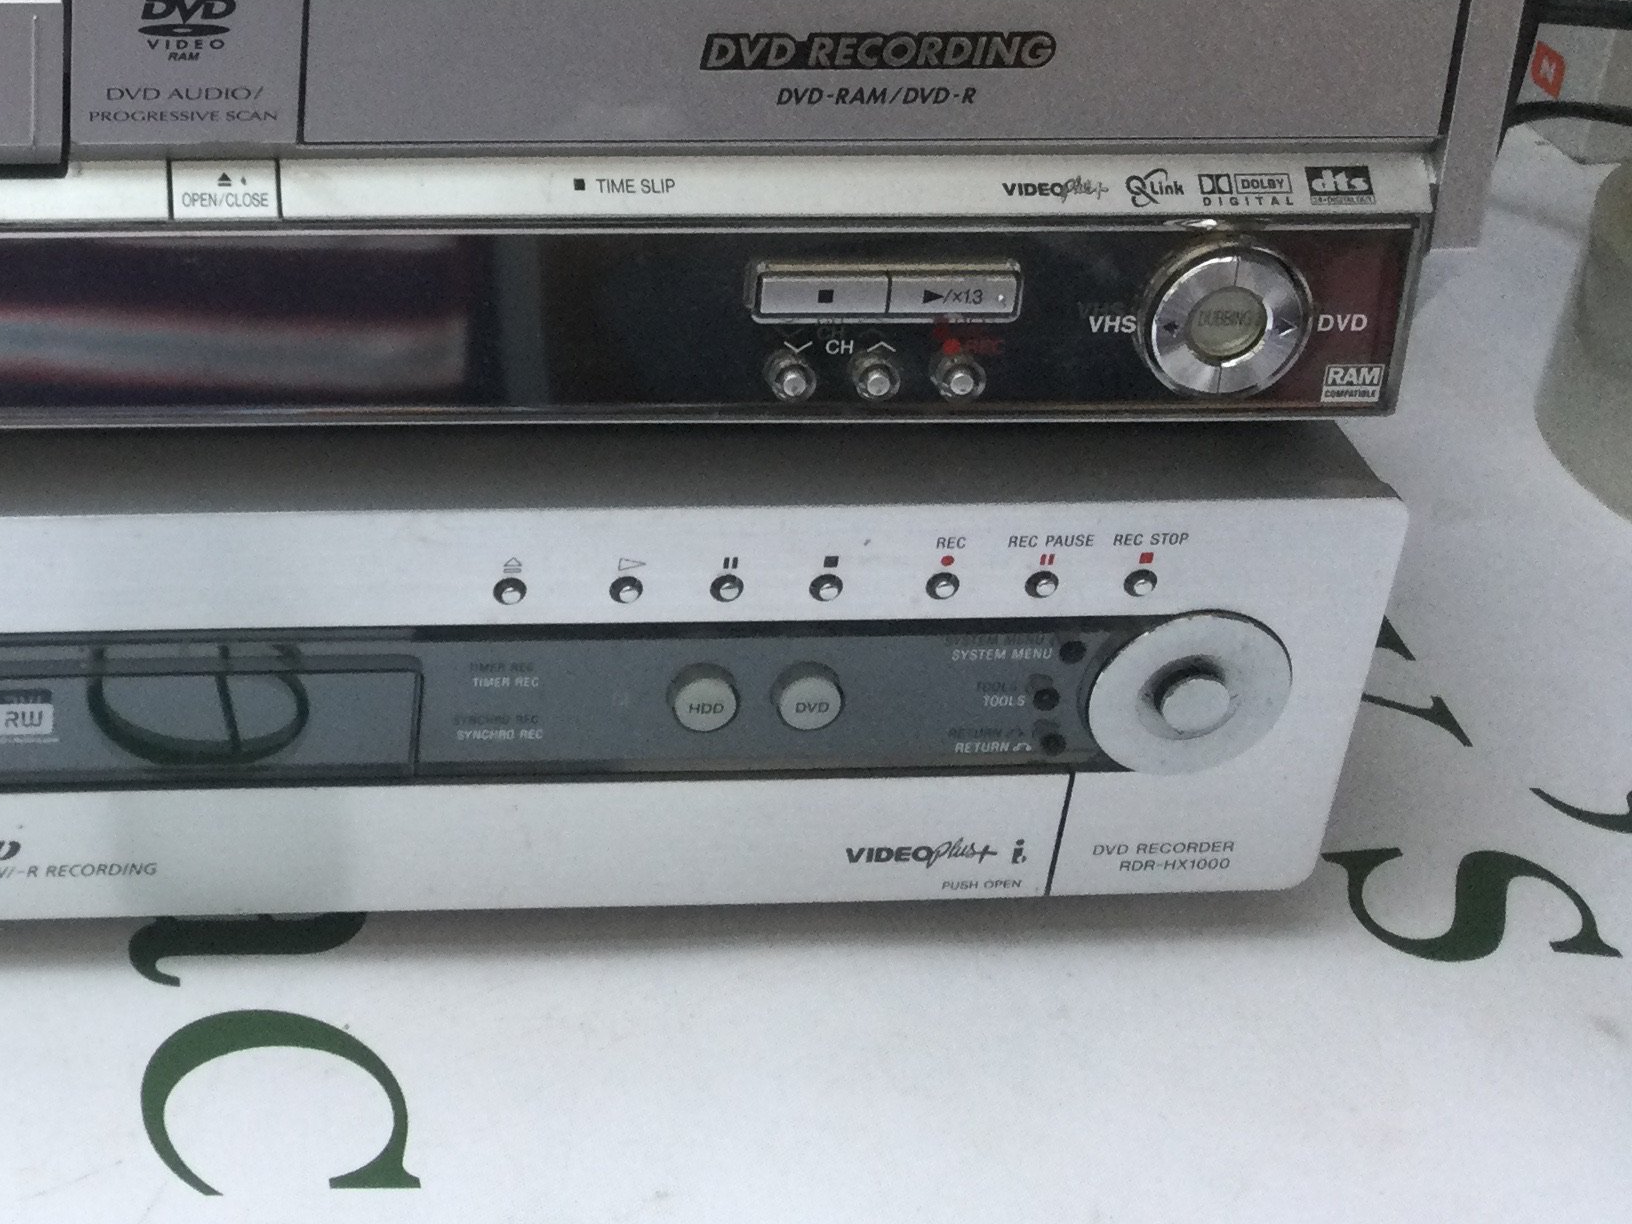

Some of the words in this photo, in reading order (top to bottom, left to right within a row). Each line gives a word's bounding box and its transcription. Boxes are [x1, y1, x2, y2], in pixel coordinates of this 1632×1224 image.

[146, 38, 225, 50] VIDEO
[704, 34, 798, 69] DVD
[807, 33, 1056, 68] RECORDING
[168, 51, 201, 62] RAM
[106, 87, 161, 101] DVD
[167, 85, 264, 101] AUDIO/
[776, 86, 977, 106] DVD-RAM/DVD-R
[88, 110, 220, 122] PROGRESSIVE
[226, 110, 278, 122] SCAN
[596, 178, 636, 194] TIME
[641, 178, 676, 194] SLIP
[1240, 177, 1284, 190] DOLBY
[1310, 168, 1373, 192] dts
[181, 192, 269, 208] OPEN/CLOSE
[1202, 196, 1294, 207] DIGITAL
[1088, 315, 1138, 333] VHS
[1317, 314, 1368, 332] DVD
[825, 340, 855, 355] CH
[1325, 366, 1382, 387] RAM
[935, 536, 967, 549] REC
[1008, 535, 1038, 548] REC
[1045, 534, 1095, 547] PAUSE
[1113, 533, 1143, 546] REC
[1150, 532, 1189, 545] STOP
[951, 648, 1006, 661] SYSTEM
[1011, 647, 1053, 660] MENU
[472, 676, 511, 688] TIMER
[515, 676, 539, 688] REC
[795, 701, 830, 714] DVD
[982, 694, 1026, 707] TOOLS
[688, 702, 725, 715] HDD
[4, 709, 44, 728] RW
[519, 728, 544, 740] REC
[954, 741, 1011, 754] RETURN
[1091, 842, 1129, 856] DVD
[1135, 841, 1236, 855] RECORDER
[45, 862, 158, 878] RECORDING
[1119, 857, 1231, 873] RDR-HX1000
[941, 880, 979, 891] PUSH
[984, 879, 1023, 890] OPEN
